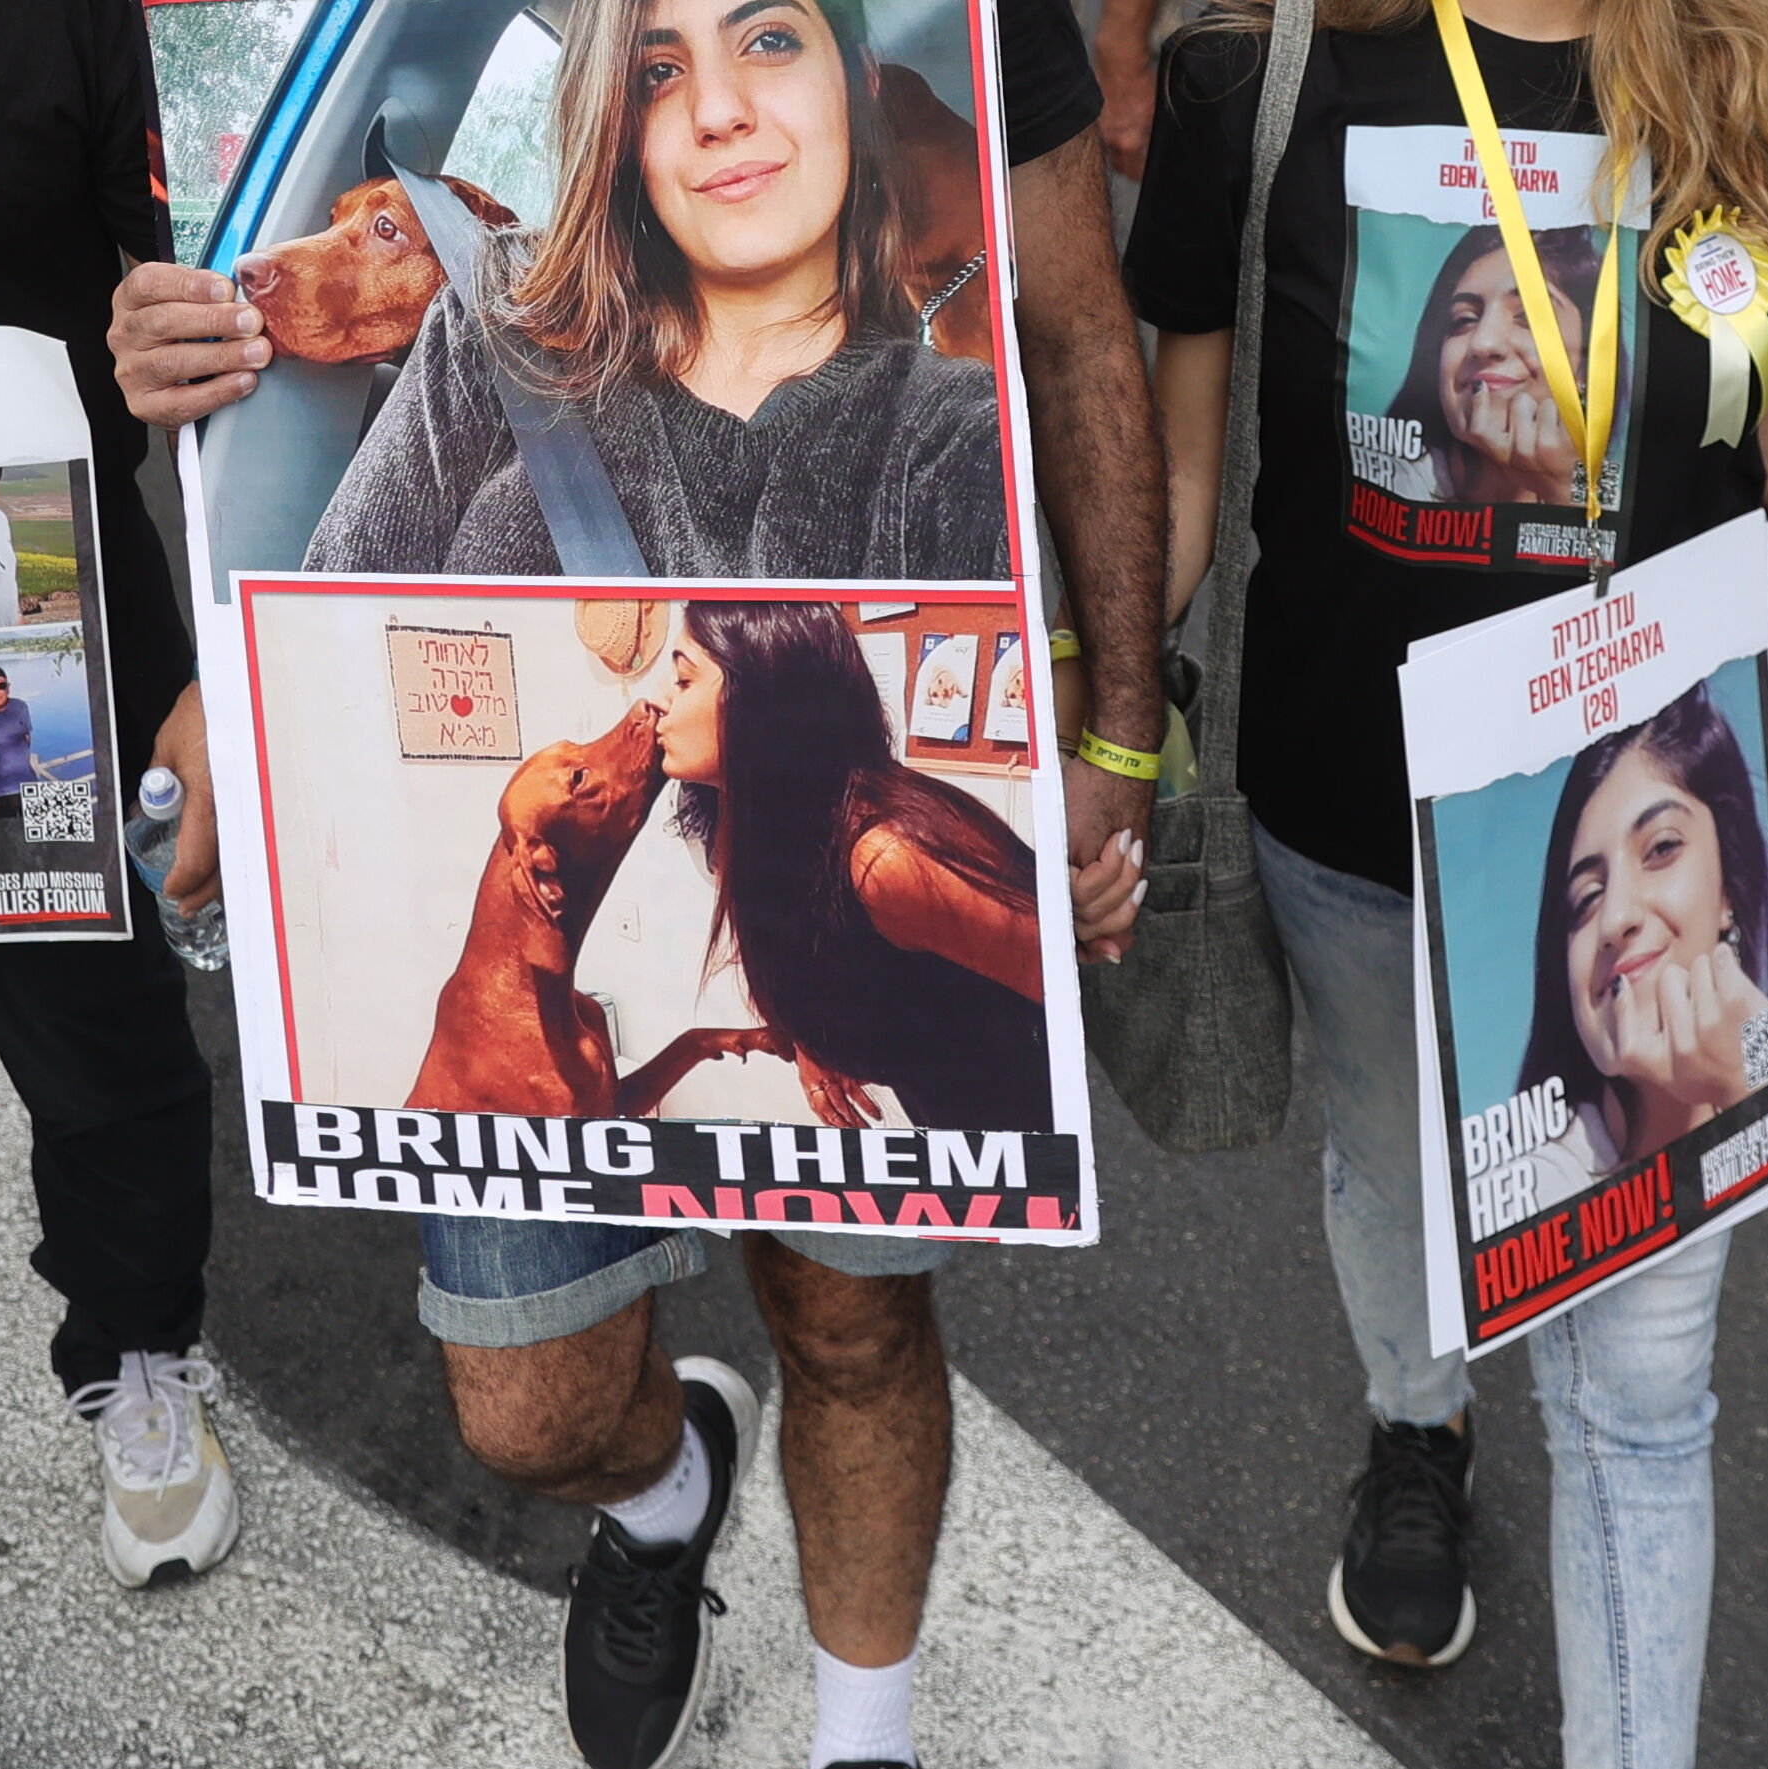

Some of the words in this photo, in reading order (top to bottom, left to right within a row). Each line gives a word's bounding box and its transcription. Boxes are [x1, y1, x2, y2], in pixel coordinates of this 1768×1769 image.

[1511, 141, 1538, 166] עדן
[1439, 164, 1477, 189] EDEN
[1480, 169, 1559, 194] HARYA
[1700, 259, 1748, 301] HOME
[1345, 410, 1423, 461] BRING
[1349, 443, 1395, 492] HER
[1350, 483, 1411, 543] HOME
[1415, 504, 1495, 551] NOW!
[1516, 535, 1571, 558] FAMILIES
[1553, 607, 1601, 660] זכריה
[1605, 591, 1636, 639] עדן
[418, 636, 489, 667] לאחותי
[1528, 662, 1573, 715] EDEN
[1575, 620, 1666, 693] ZECHARYA
[408, 692, 449, 714] טוב
[431, 668, 494, 696] היקרה
[471, 688, 508, 717] מזל
[1583, 682, 1619, 735] (28)
[21, 873, 47, 891] AND
[48, 871, 104, 890] MISSING
[43, 888, 108, 915] FORUM
[293, 1103, 654, 1177] BRING
[695, 1122, 1028, 1189] THEM
[1461, 1076, 1570, 1180] BRING
[270, 1161, 595, 1217] HOME
[641, 1182, 1081, 1231] NOW!
[1703, 1143, 1764, 1202] FAMILIES
[1466, 1159, 1541, 1244] HER
[1474, 1211, 1575, 1312] HOME
[1578, 1151, 1676, 1261] NOW!
